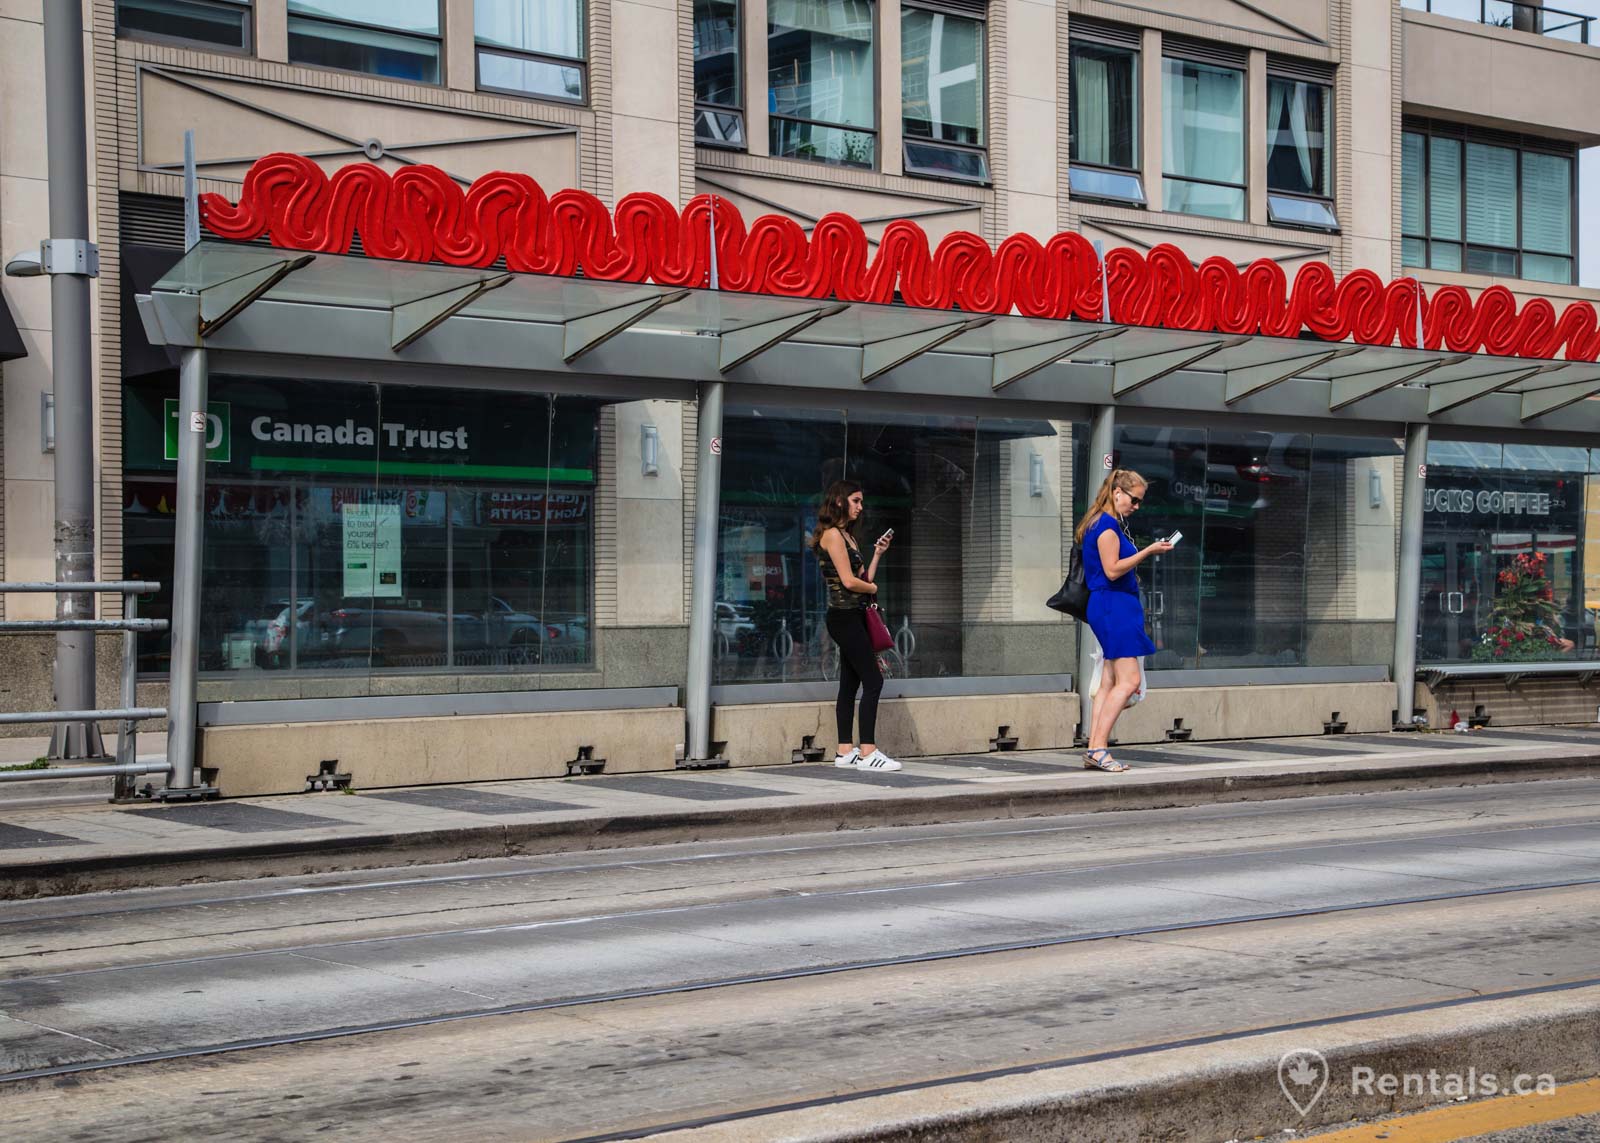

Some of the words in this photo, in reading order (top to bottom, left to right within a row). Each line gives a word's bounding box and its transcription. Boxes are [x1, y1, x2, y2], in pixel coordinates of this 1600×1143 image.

[251, 415, 374, 446] Canada
[383, 422, 468, 450] Trust
[1175, 481, 1202, 496] Open
[1213, 483, 1238, 498] Days
[1475, 489, 1550, 515] COFFEE
[347, 530, 377, 540] yoursel
